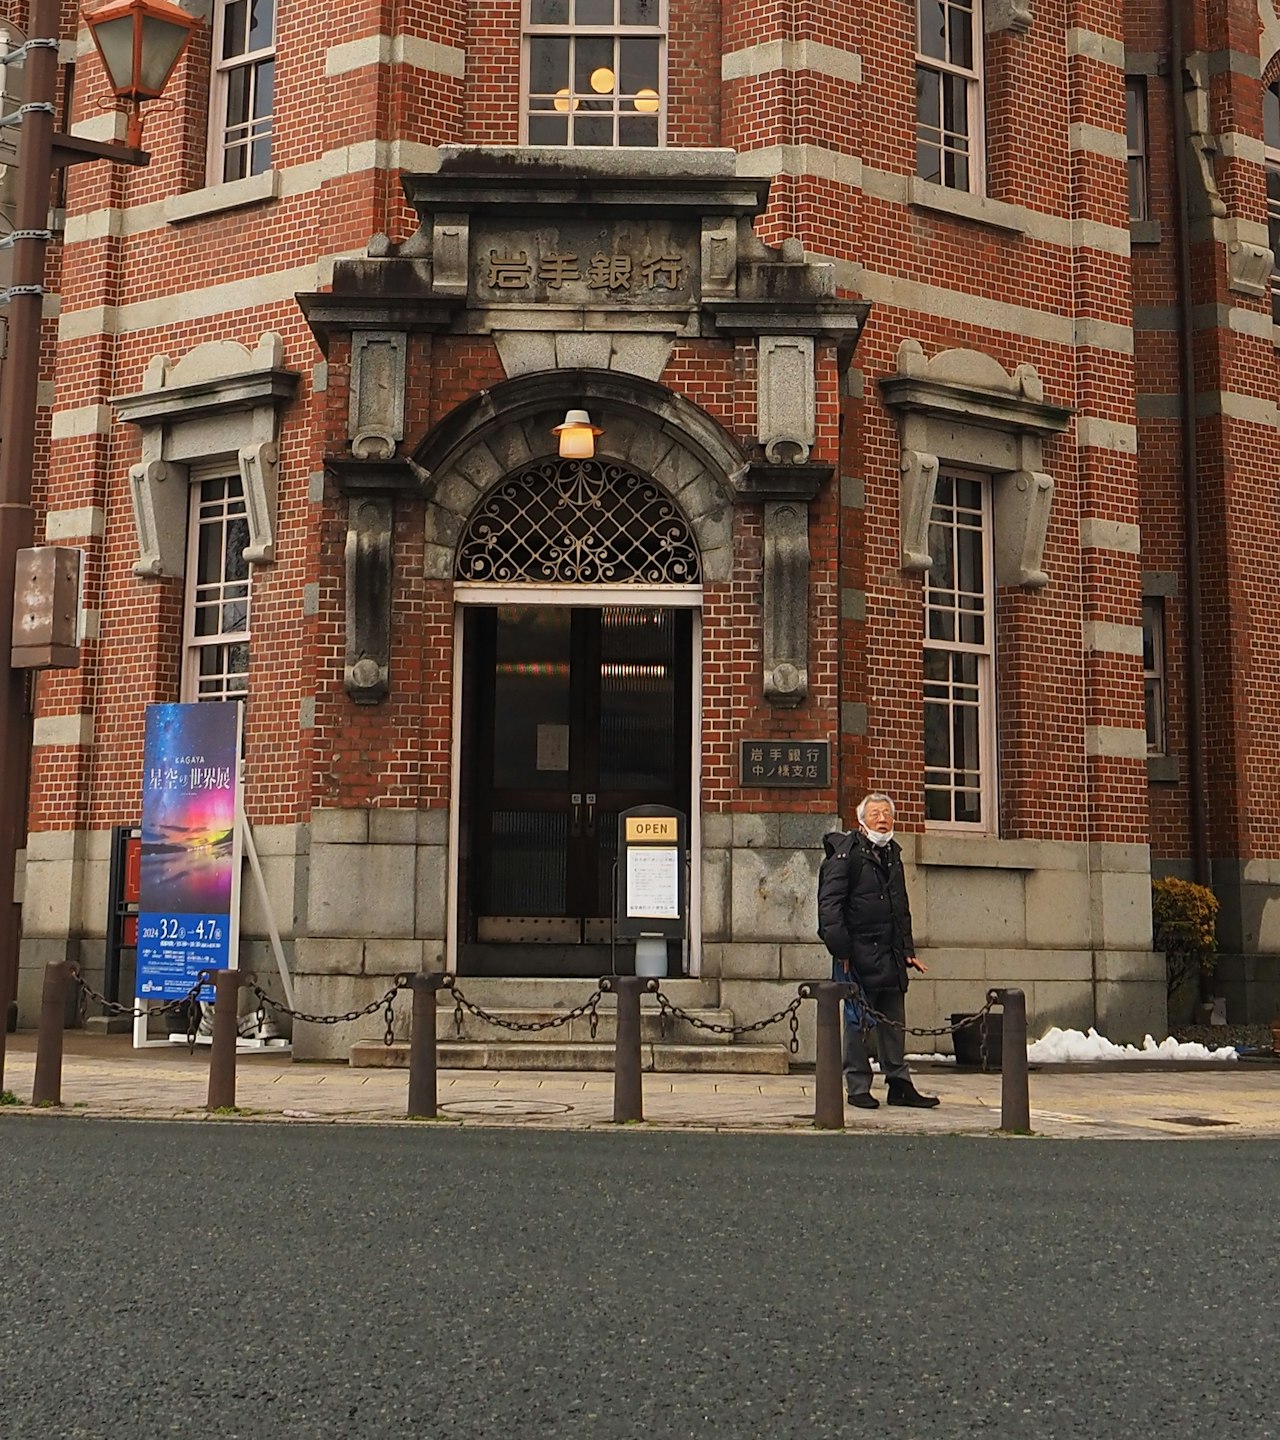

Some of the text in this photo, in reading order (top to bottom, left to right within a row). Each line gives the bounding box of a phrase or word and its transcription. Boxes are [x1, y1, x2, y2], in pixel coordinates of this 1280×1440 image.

[488, 250, 683, 289] 岩手銀行
[175, 756, 205, 764] KAGAYA
[750, 747, 820, 762] 岩手銀行
[149, 767, 231, 790] 星空の世界展
[751, 764, 818, 778] 中ノ橋支店
[636, 823, 668, 834] OPEN
[142, 928, 159, 938] 2024
[160, 918, 178, 939] 3.2
[195, 919, 217, 939] 4.7
